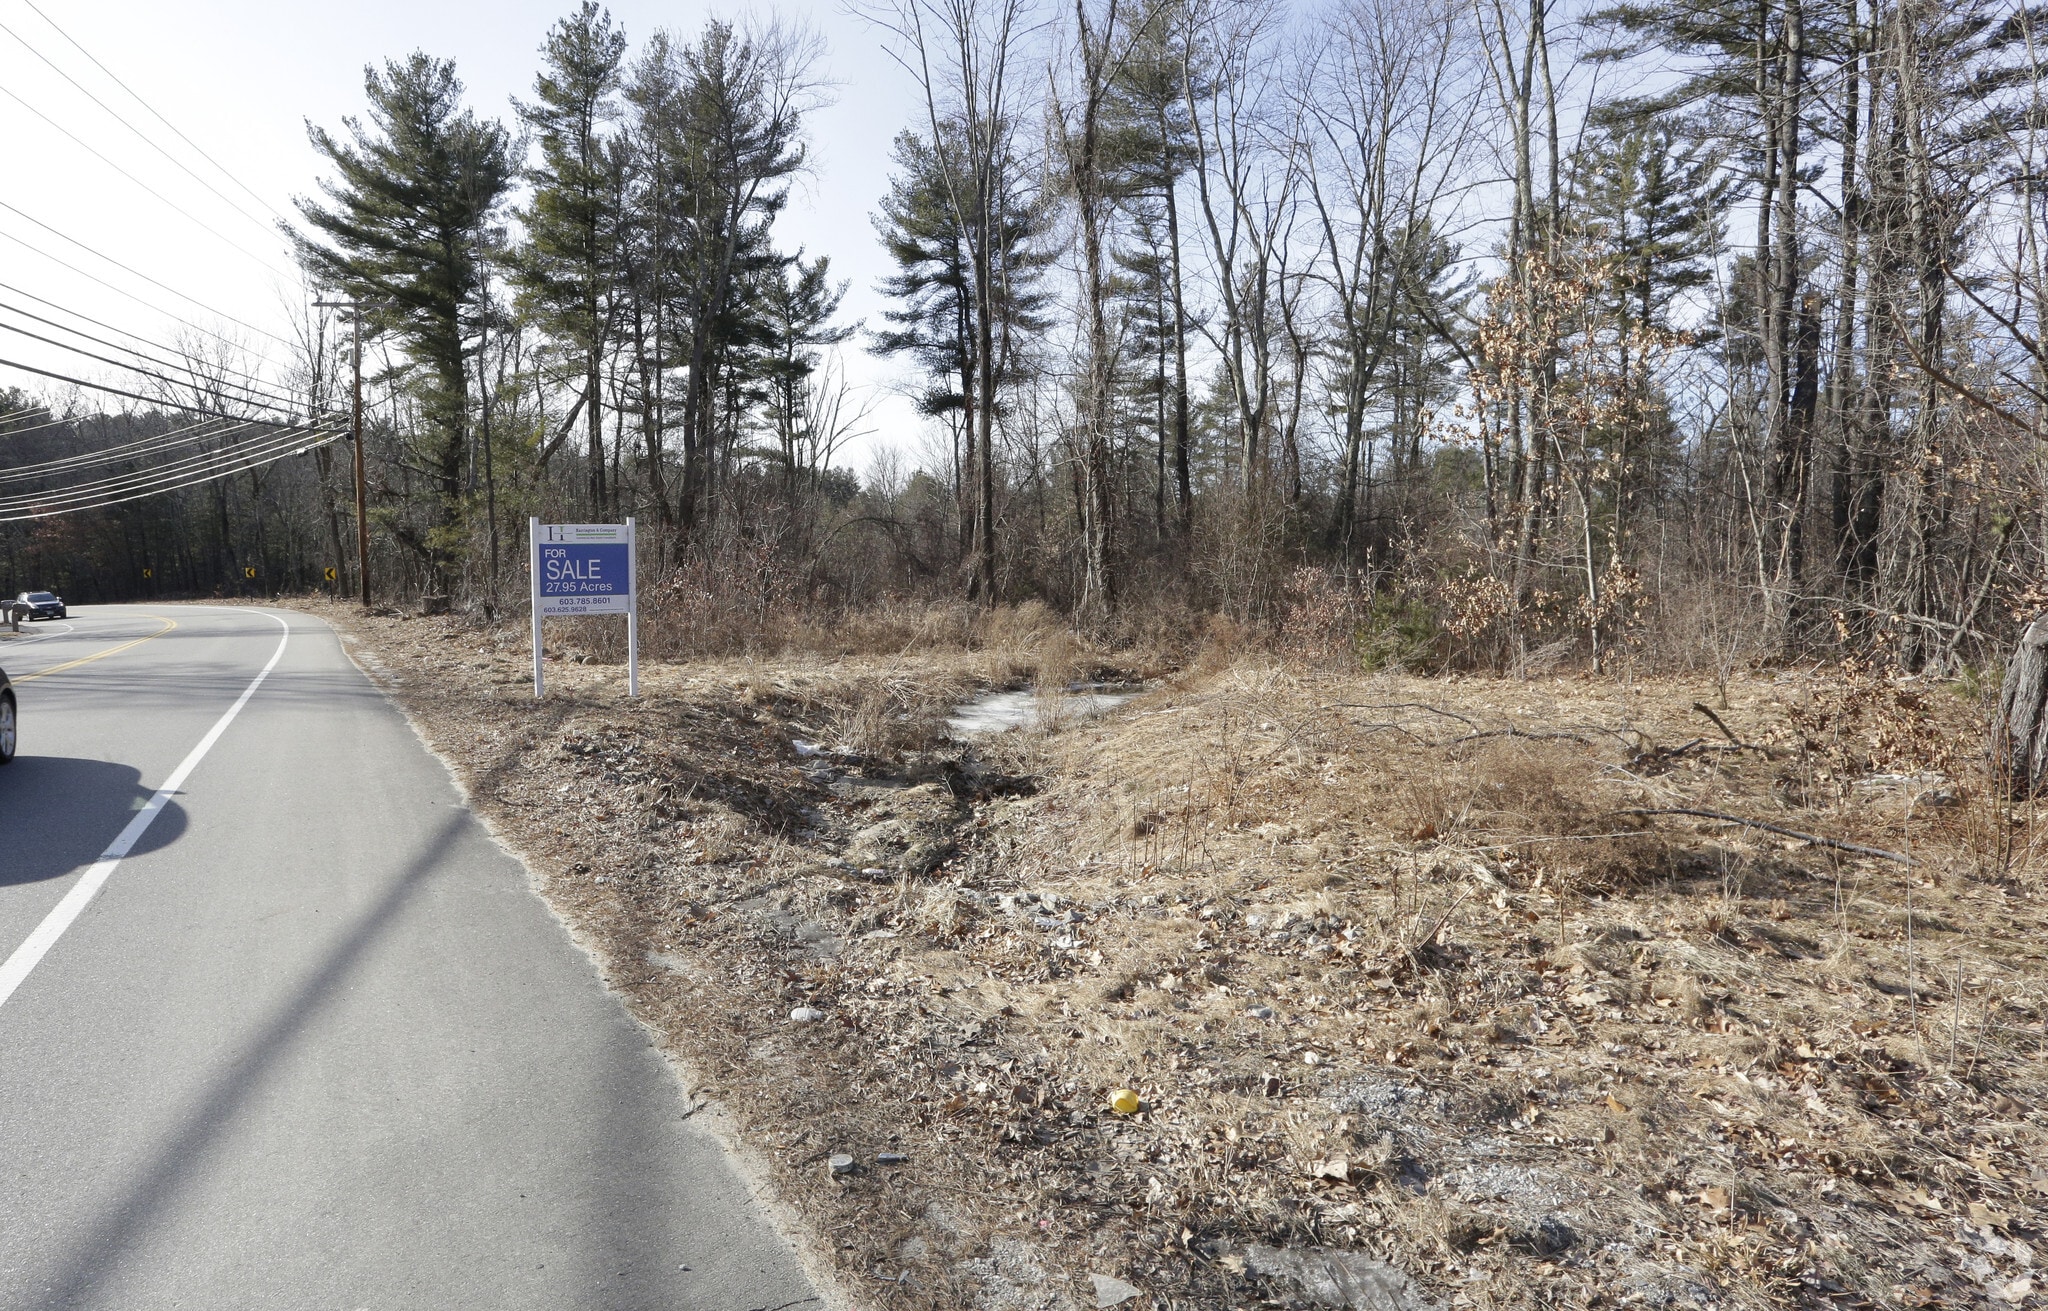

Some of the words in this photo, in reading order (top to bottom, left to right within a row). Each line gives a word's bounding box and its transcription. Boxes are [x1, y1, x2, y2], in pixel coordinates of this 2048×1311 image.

[545, 549, 566, 558] FOR
[546, 559, 601, 580] SALE
[546, 582, 576, 593] 27.95
[580, 581, 612, 592] Acres
[559, 597, 611, 605] 603.785.8601
